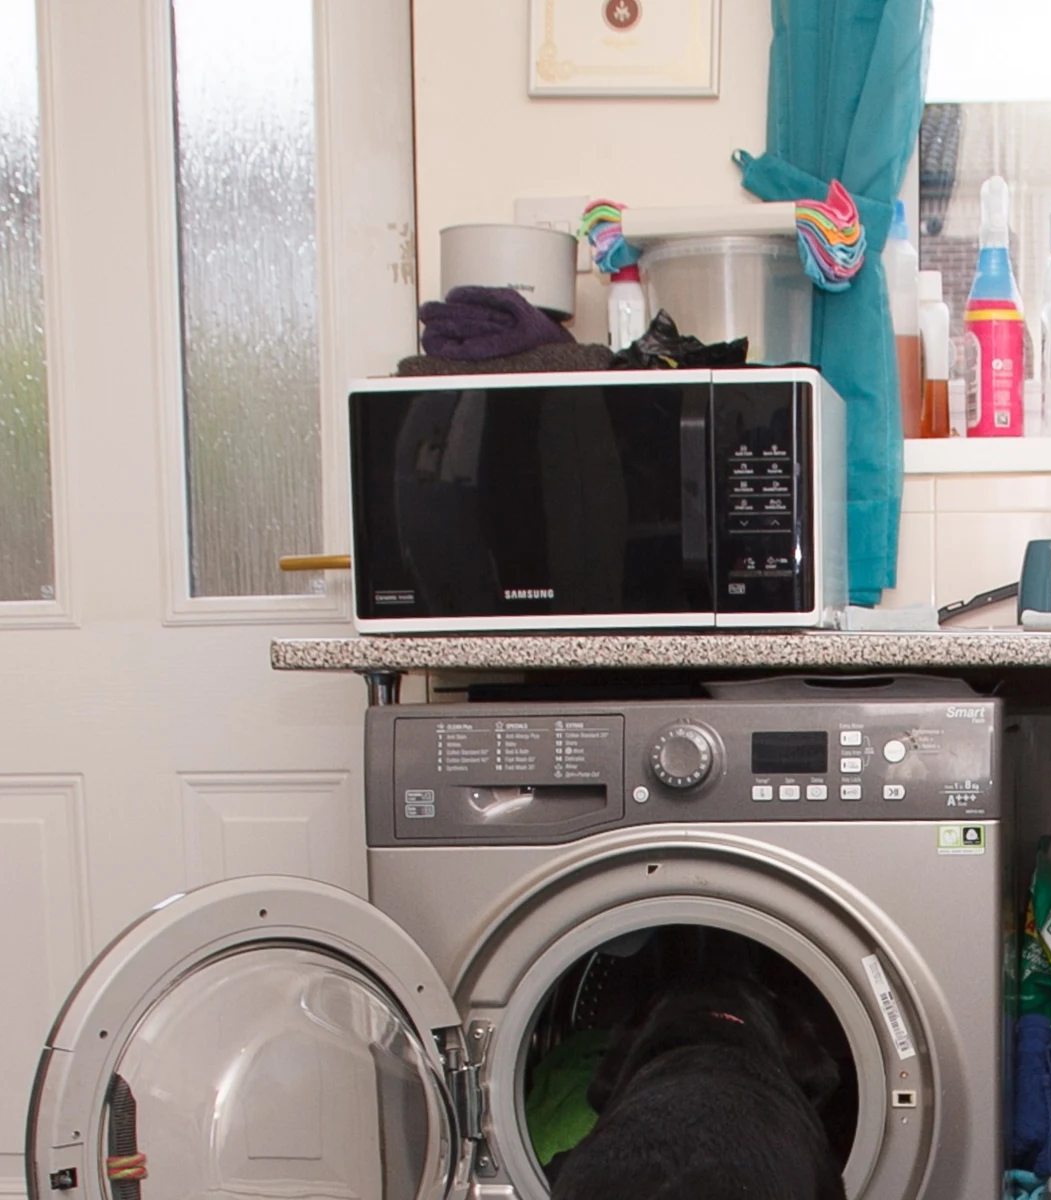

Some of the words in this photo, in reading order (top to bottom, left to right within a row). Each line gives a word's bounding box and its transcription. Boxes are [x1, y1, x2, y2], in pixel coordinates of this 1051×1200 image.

[504, 589, 554, 600] SAMSUNG
[946, 706, 985, 718] Smart
[964, 779, 972, 790] 8
